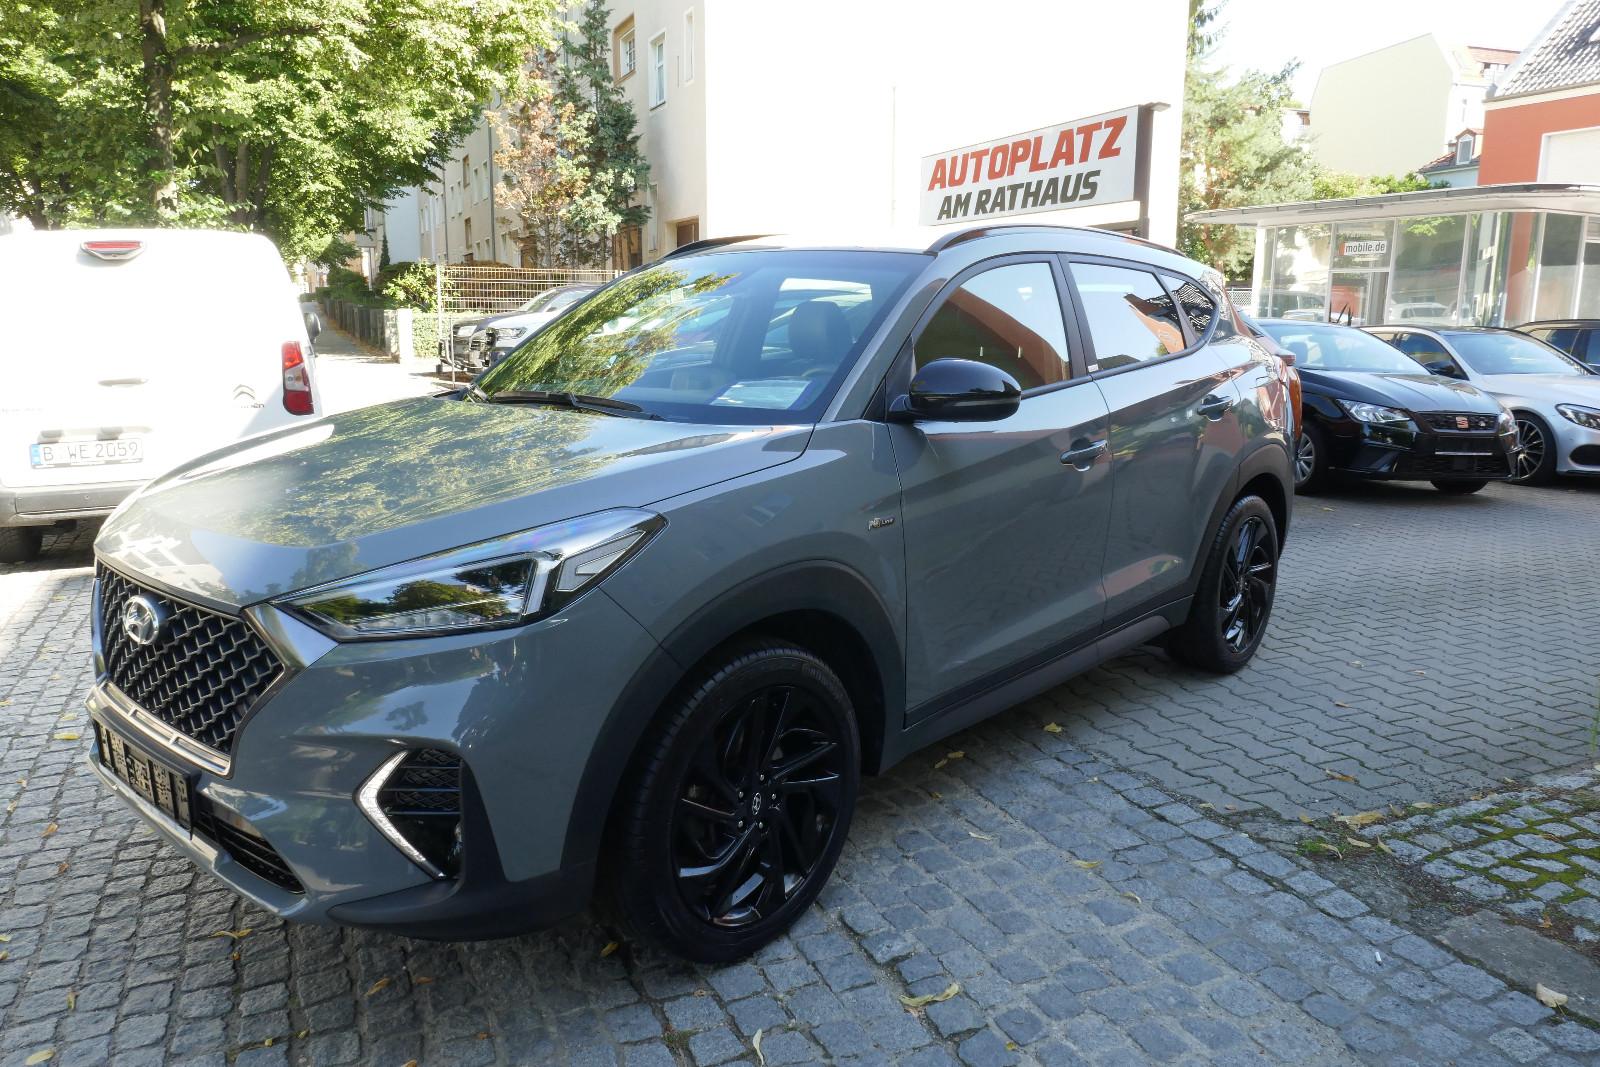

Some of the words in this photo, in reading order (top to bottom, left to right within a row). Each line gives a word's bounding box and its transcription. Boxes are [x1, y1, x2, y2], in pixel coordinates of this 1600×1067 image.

[928, 115, 1128, 191] AUTOPLATZ
[937, 192, 972, 220] AM
[974, 169, 1101, 216] RATHAUS
[1345, 243, 1384, 253] mobile.de
[43, 446, 54, 462] B
[67, 445, 91, 459] WE
[95, 441, 138, 458] 2059
